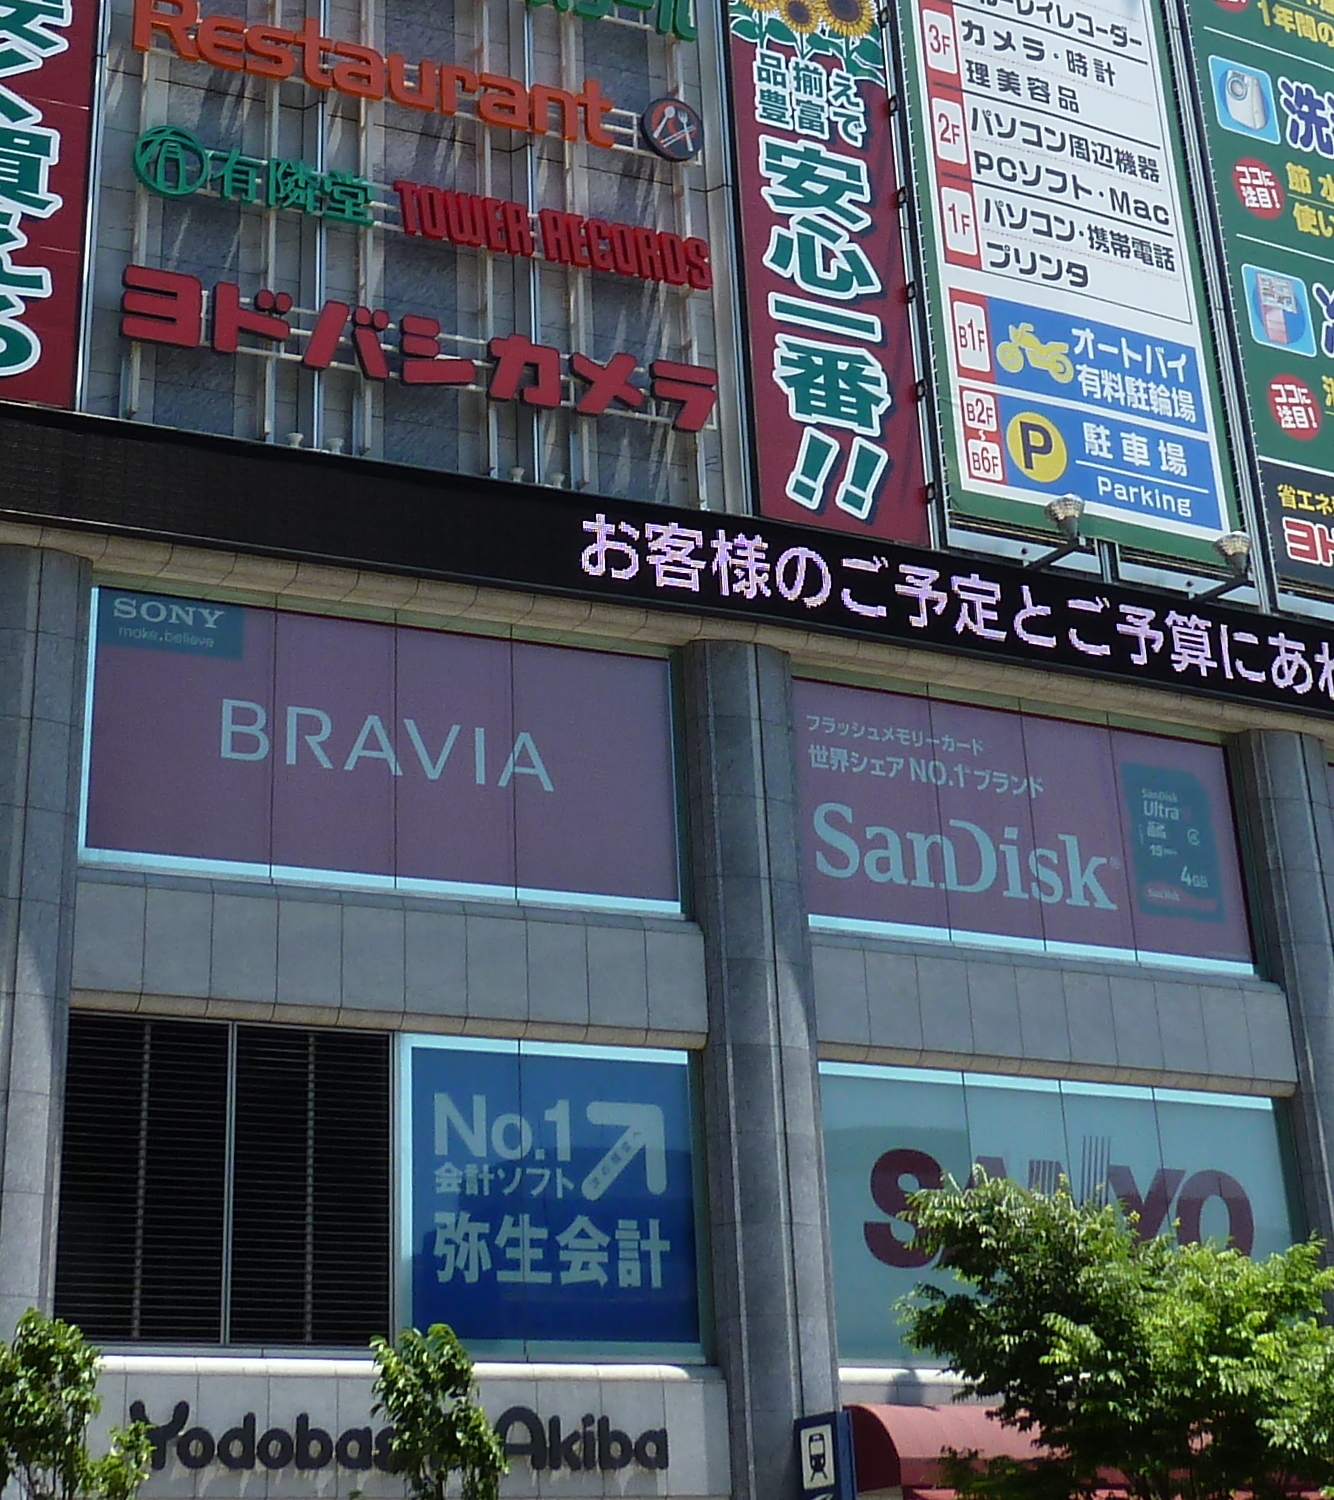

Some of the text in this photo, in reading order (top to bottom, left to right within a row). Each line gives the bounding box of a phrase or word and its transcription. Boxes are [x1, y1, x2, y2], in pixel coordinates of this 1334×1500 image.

[928, 24, 951, 55] 3F
[754, 50, 865, 113] 品揃え
[965, 59, 1081, 115] 理美容品
[754, 87, 867, 149] 豊富で
[937, 112, 961, 143] 2F
[971, 107, 1161, 184] パソコン周辺機器
[210, 147, 715, 291] 有隣堂 TOWER RECORDS
[947, 204, 971, 236] 1F
[986, 242, 1090, 289] プリンタ
[120, 264, 719, 433] ヨドバシカメラ
[760, 135, 892, 520] 安心一番!!
[959, 319, 986, 353] B1F
[1070, 327, 1188, 384] オートバイ
[967, 396, 994, 427] B2F
[1077, 364, 1197, 424] 有料駐輪場
[971, 446, 1000, 475] B6F
[1019, 420, 1054, 471] P
[1082, 421, 1189, 478] 駐車場
[1097, 476, 1193, 518] Parking
[113, 597, 225, 629] SONY
[220, 698, 555, 793] BRAVIA
[807, 714, 984, 756] フラッシュメモリーカード
[1143, 800, 1180, 821] Ultra
[813, 802, 1119, 911] SanDisk
[433, 1092, 572, 1162] No.1
[433, 1160, 575, 1200] 会計ソフト
[863, 1134, 1256, 1269] SYO
[432, 1210, 671, 1290] 弥生会計
